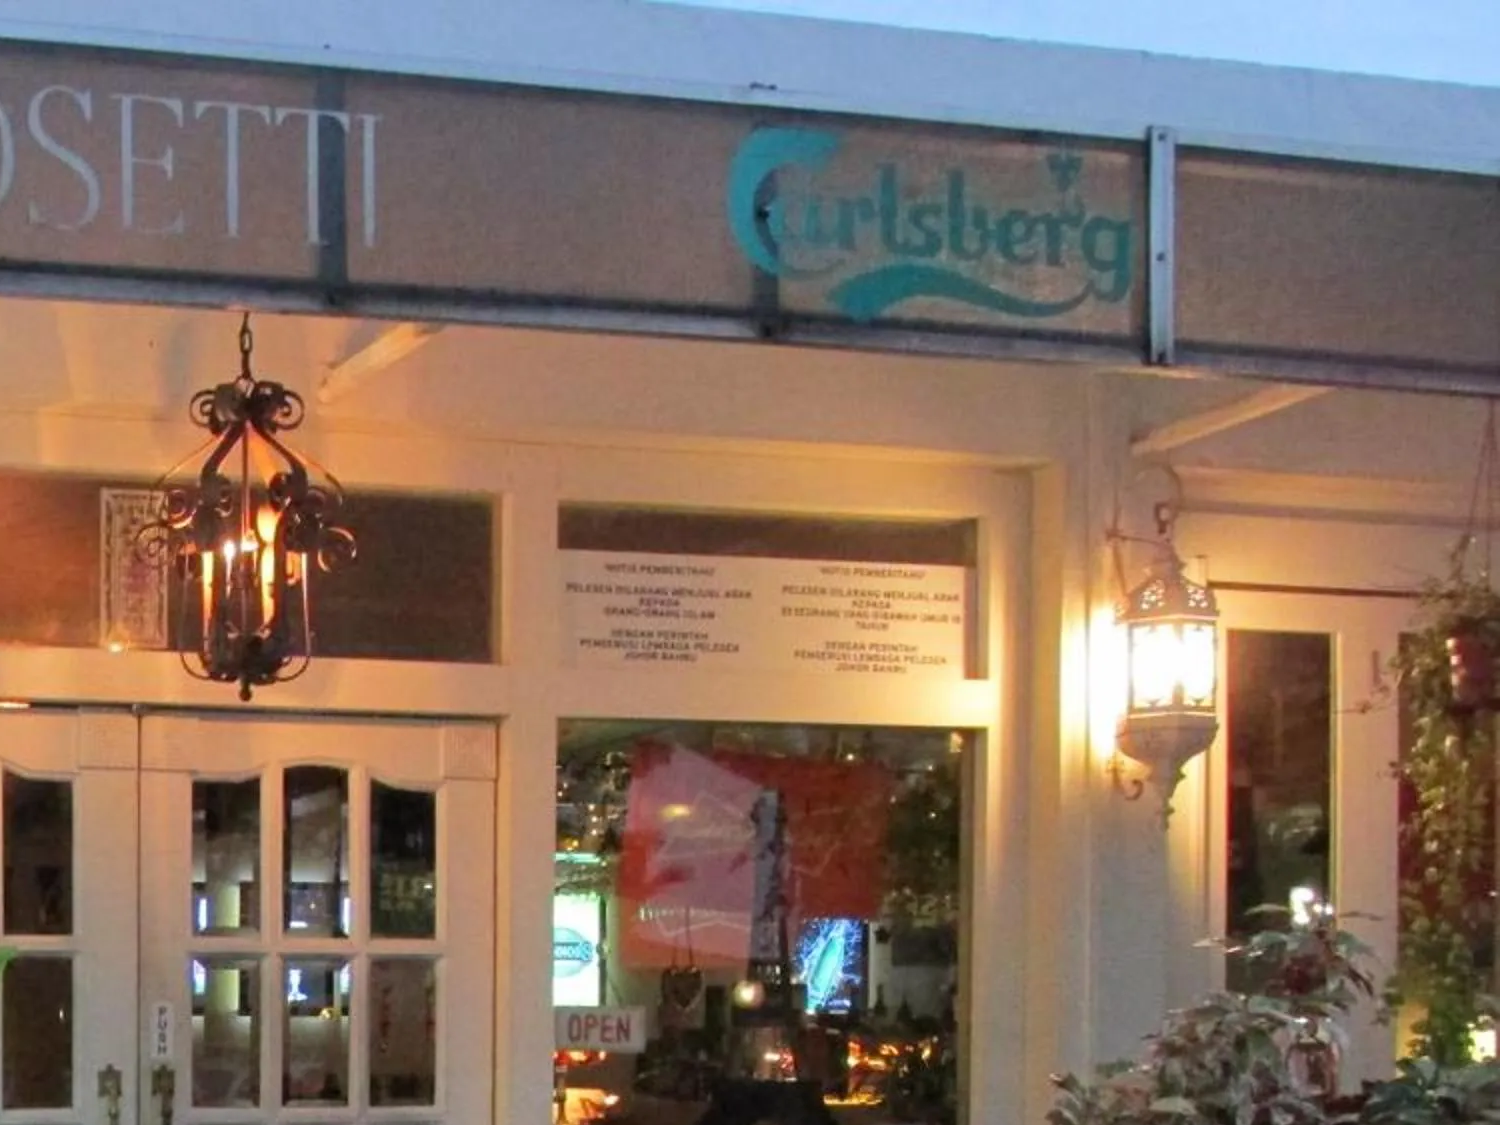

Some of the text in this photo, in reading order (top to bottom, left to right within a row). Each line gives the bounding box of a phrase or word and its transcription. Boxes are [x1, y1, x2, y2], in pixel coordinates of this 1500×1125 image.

[727, 123, 1133, 302] Carlsberg
[157, 1005, 168, 1056] PUSH
[567, 1013, 632, 1044] OPEN
